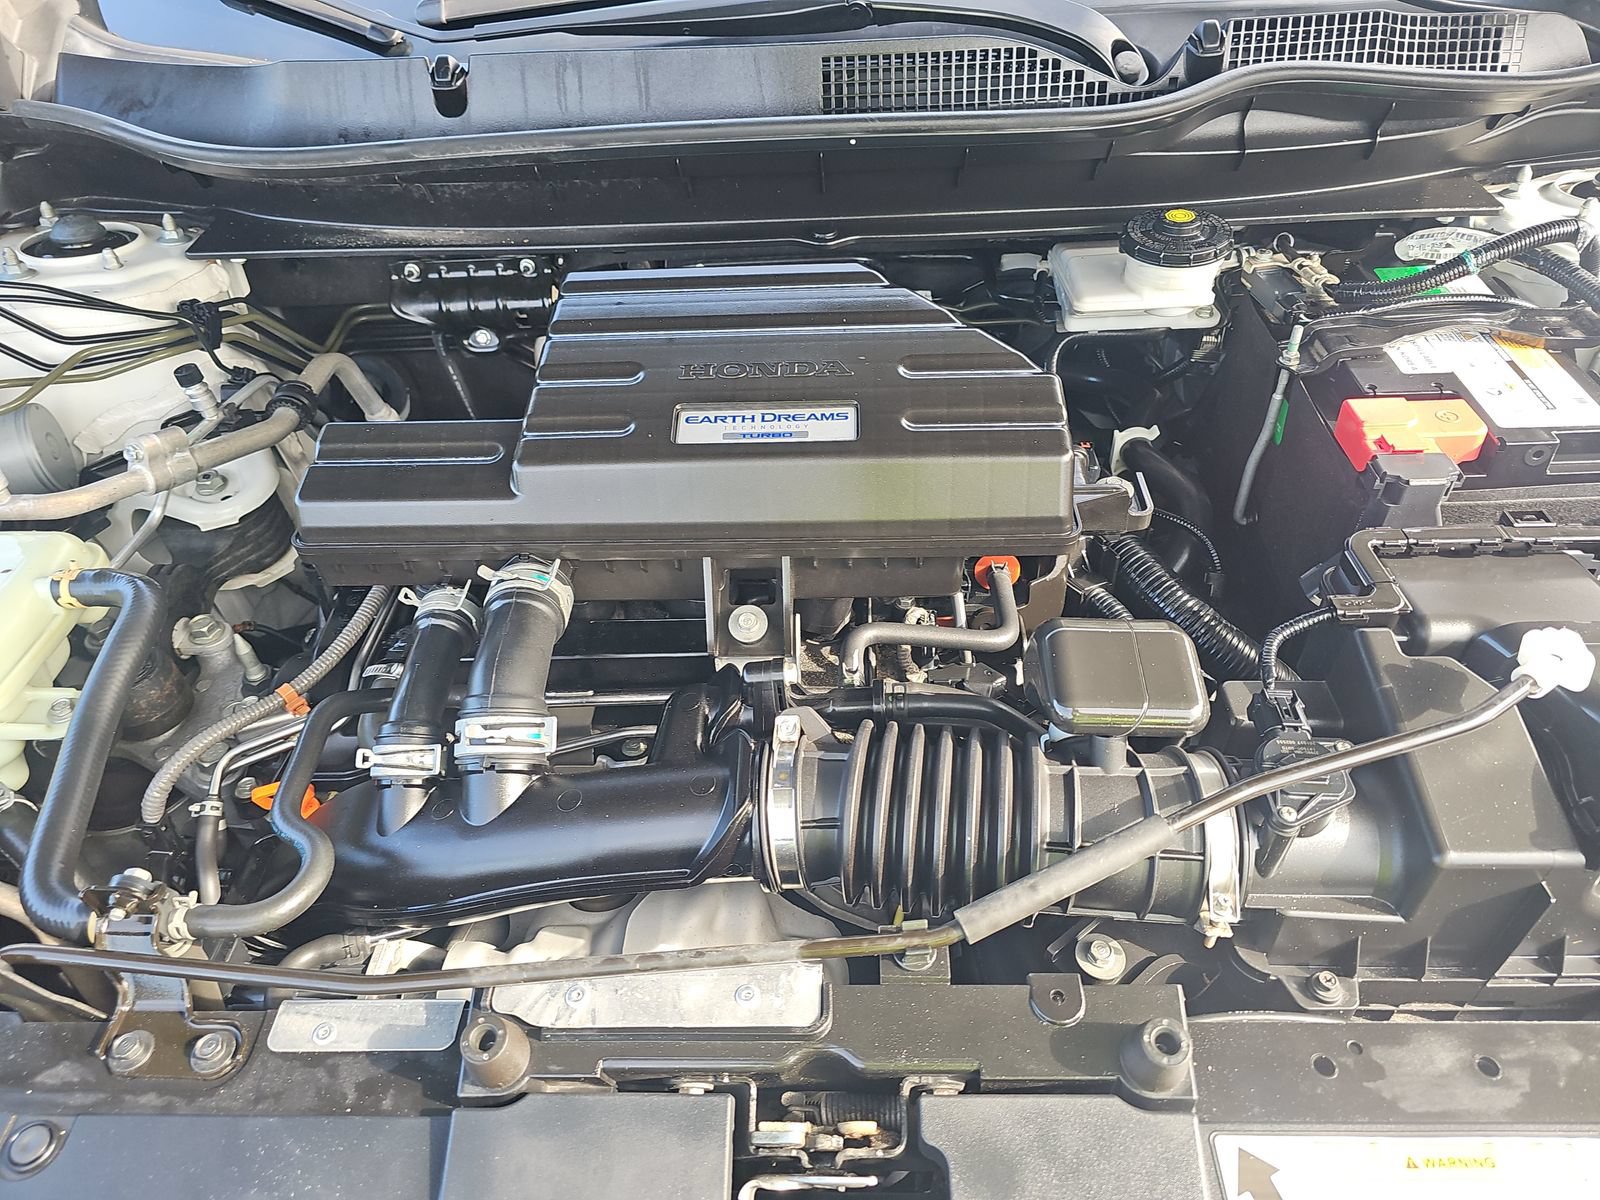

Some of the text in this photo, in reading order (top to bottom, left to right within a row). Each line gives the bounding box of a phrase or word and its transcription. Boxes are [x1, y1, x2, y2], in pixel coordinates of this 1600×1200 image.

[678, 359, 855, 380] HONDA
[685, 412, 849, 425] EARTH DREAMS
[723, 423, 809, 431] TECHNOLOGY
[740, 431, 793, 439] TURBO
[1424, 1157, 1496, 1169] WARNING
